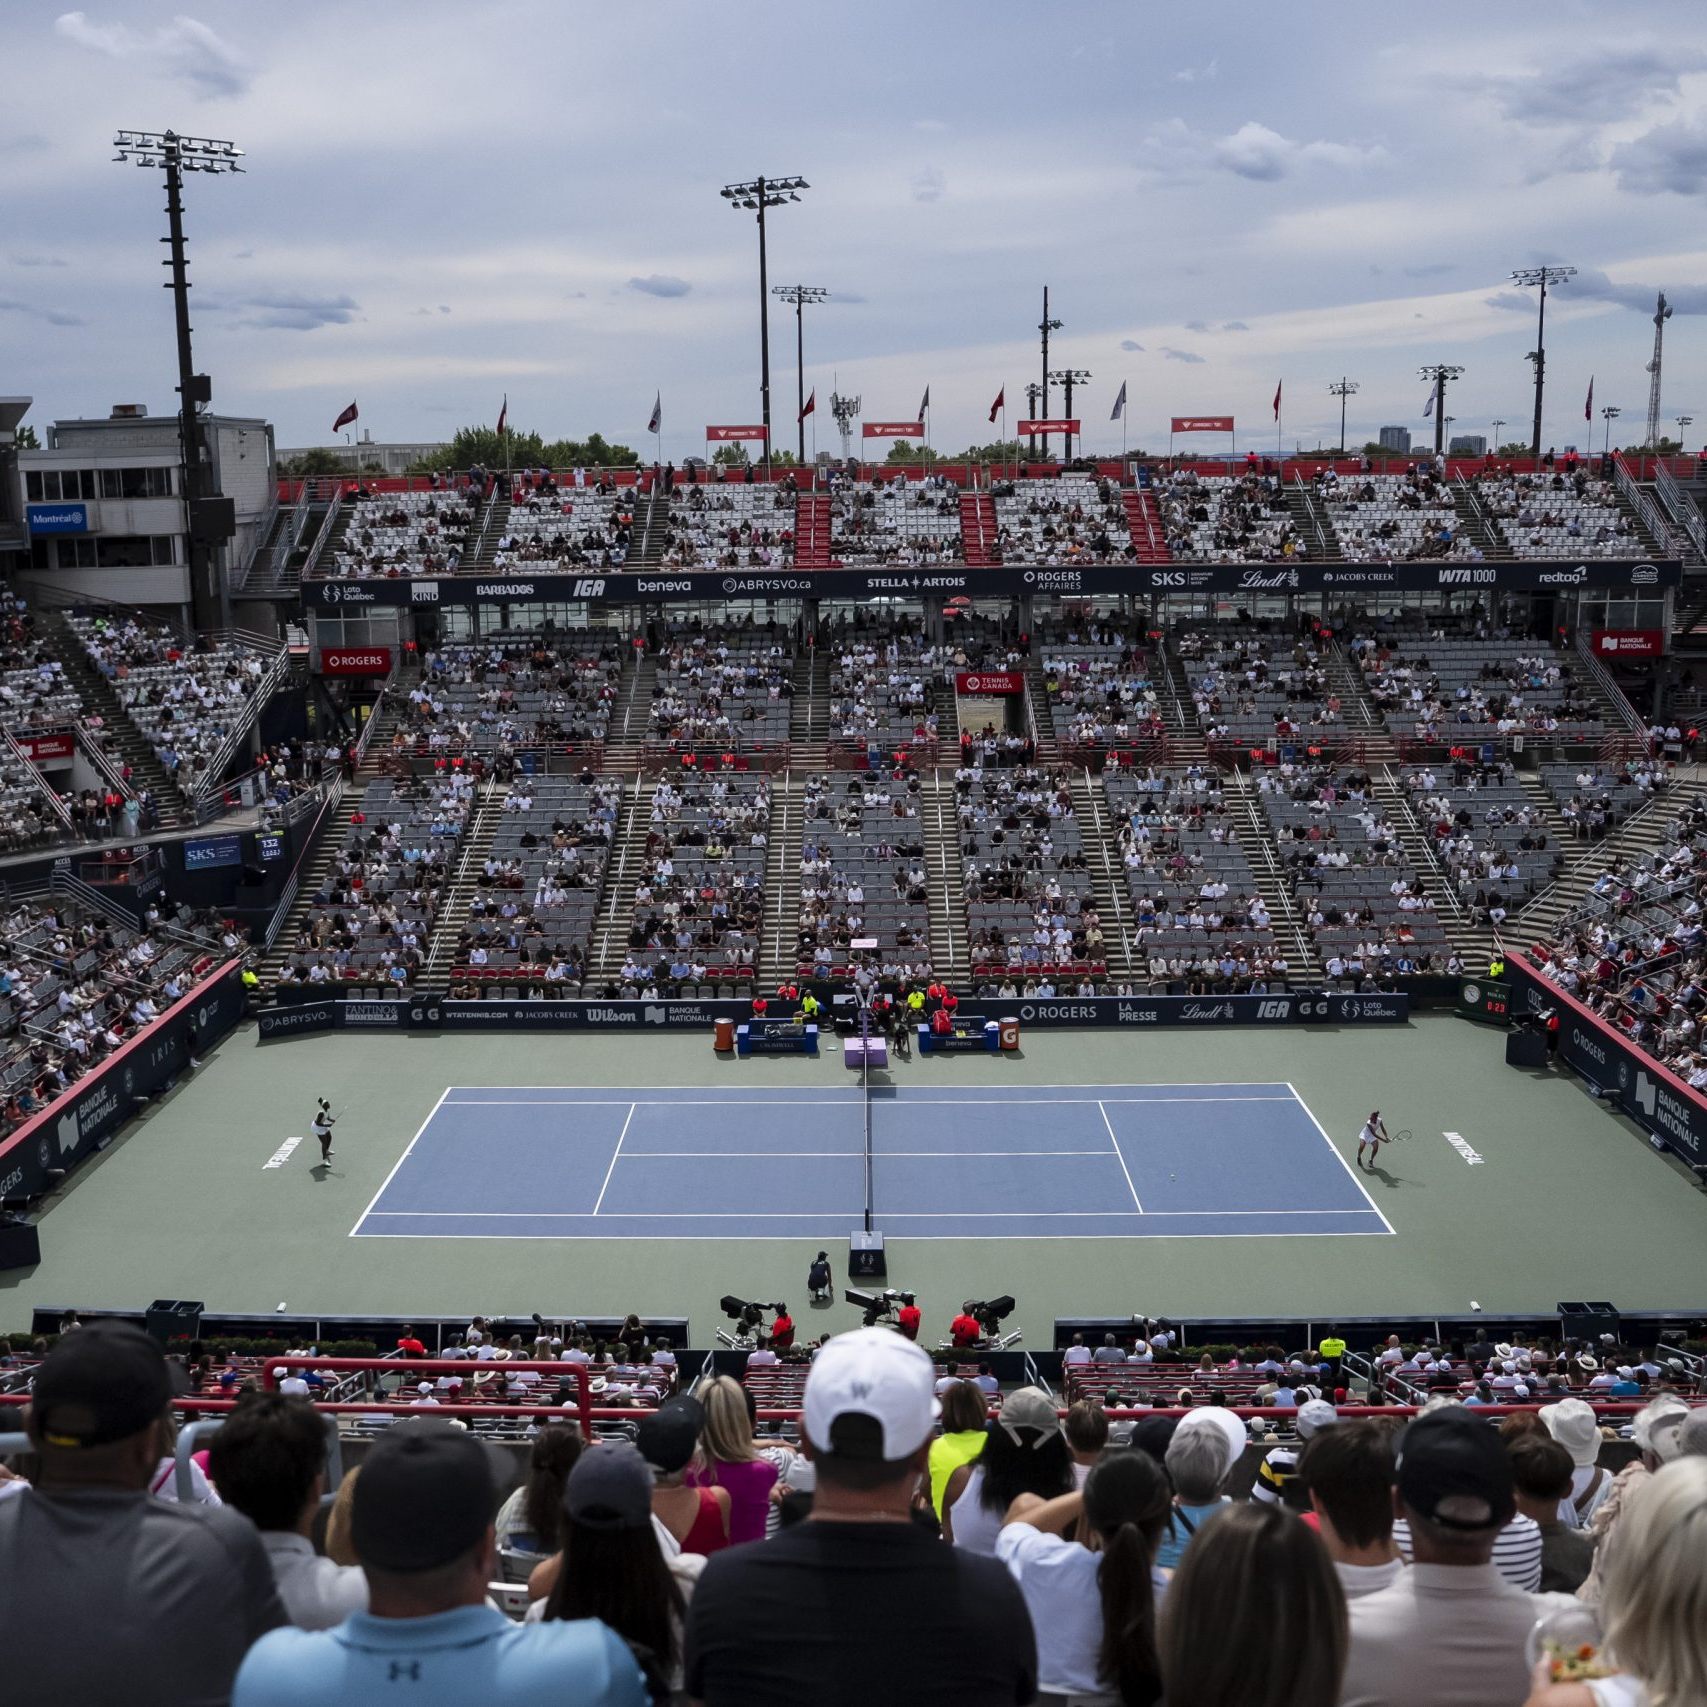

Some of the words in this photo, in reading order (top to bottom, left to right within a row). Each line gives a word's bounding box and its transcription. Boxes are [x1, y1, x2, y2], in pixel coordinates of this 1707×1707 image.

[33, 514, 72, 524] Montréal
[1037, 571, 1082, 581] ROGERS
[1151, 572, 1186, 586] SKS
[1238, 570, 1288, 588] Lindt
[1367, 573, 1394, 581] CREEK
[1438, 569, 1471, 583] WTA
[1472, 569, 1496, 583] 1000
[573, 580, 606, 597] IGA
[637, 579, 692, 592] beneva
[737, 579, 812, 591] ABRYSVO.ca
[867, 577, 909, 588] STELLA
[922, 577, 966, 587] ARTOIS
[1037, 581, 1082, 590] AFFAIRES
[343, 585, 361, 593] Loto
[476, 584, 535, 596] BARBADOS
[343, 592, 375, 600] Québec
[411, 592, 439, 601] KIND
[341, 656, 383, 665] ROGERS
[669, 1006, 701, 1015] BANQUE
[1038, 1006, 1097, 1019] ROGERS
[1118, 1002, 1132, 1011] LA
[1179, 1002, 1223, 1019] Lindt
[1256, 1001, 1290, 1018] IGA
[1363, 1007, 1397, 1017] Québec
[446, 1011, 508, 1019] WTATENNIS.COM
[555, 1011, 578, 1019] CREEK
[586, 1008, 636, 1022] Wilson
[669, 1014, 712, 1022] NATIONALE
[1118, 1012, 1157, 1021] PRESSE
[1003, 1028, 1017, 1044] G
[1580, 1034, 1606, 1065] ROGERS
[79, 1085, 108, 1120] BANQUE
[1658, 1089, 1690, 1125] BANQUE
[81, 1094, 118, 1136] NATIONALE
[1657, 1106, 1700, 1152] NATIONALE
[0, 1166, 23, 1195] GERS
